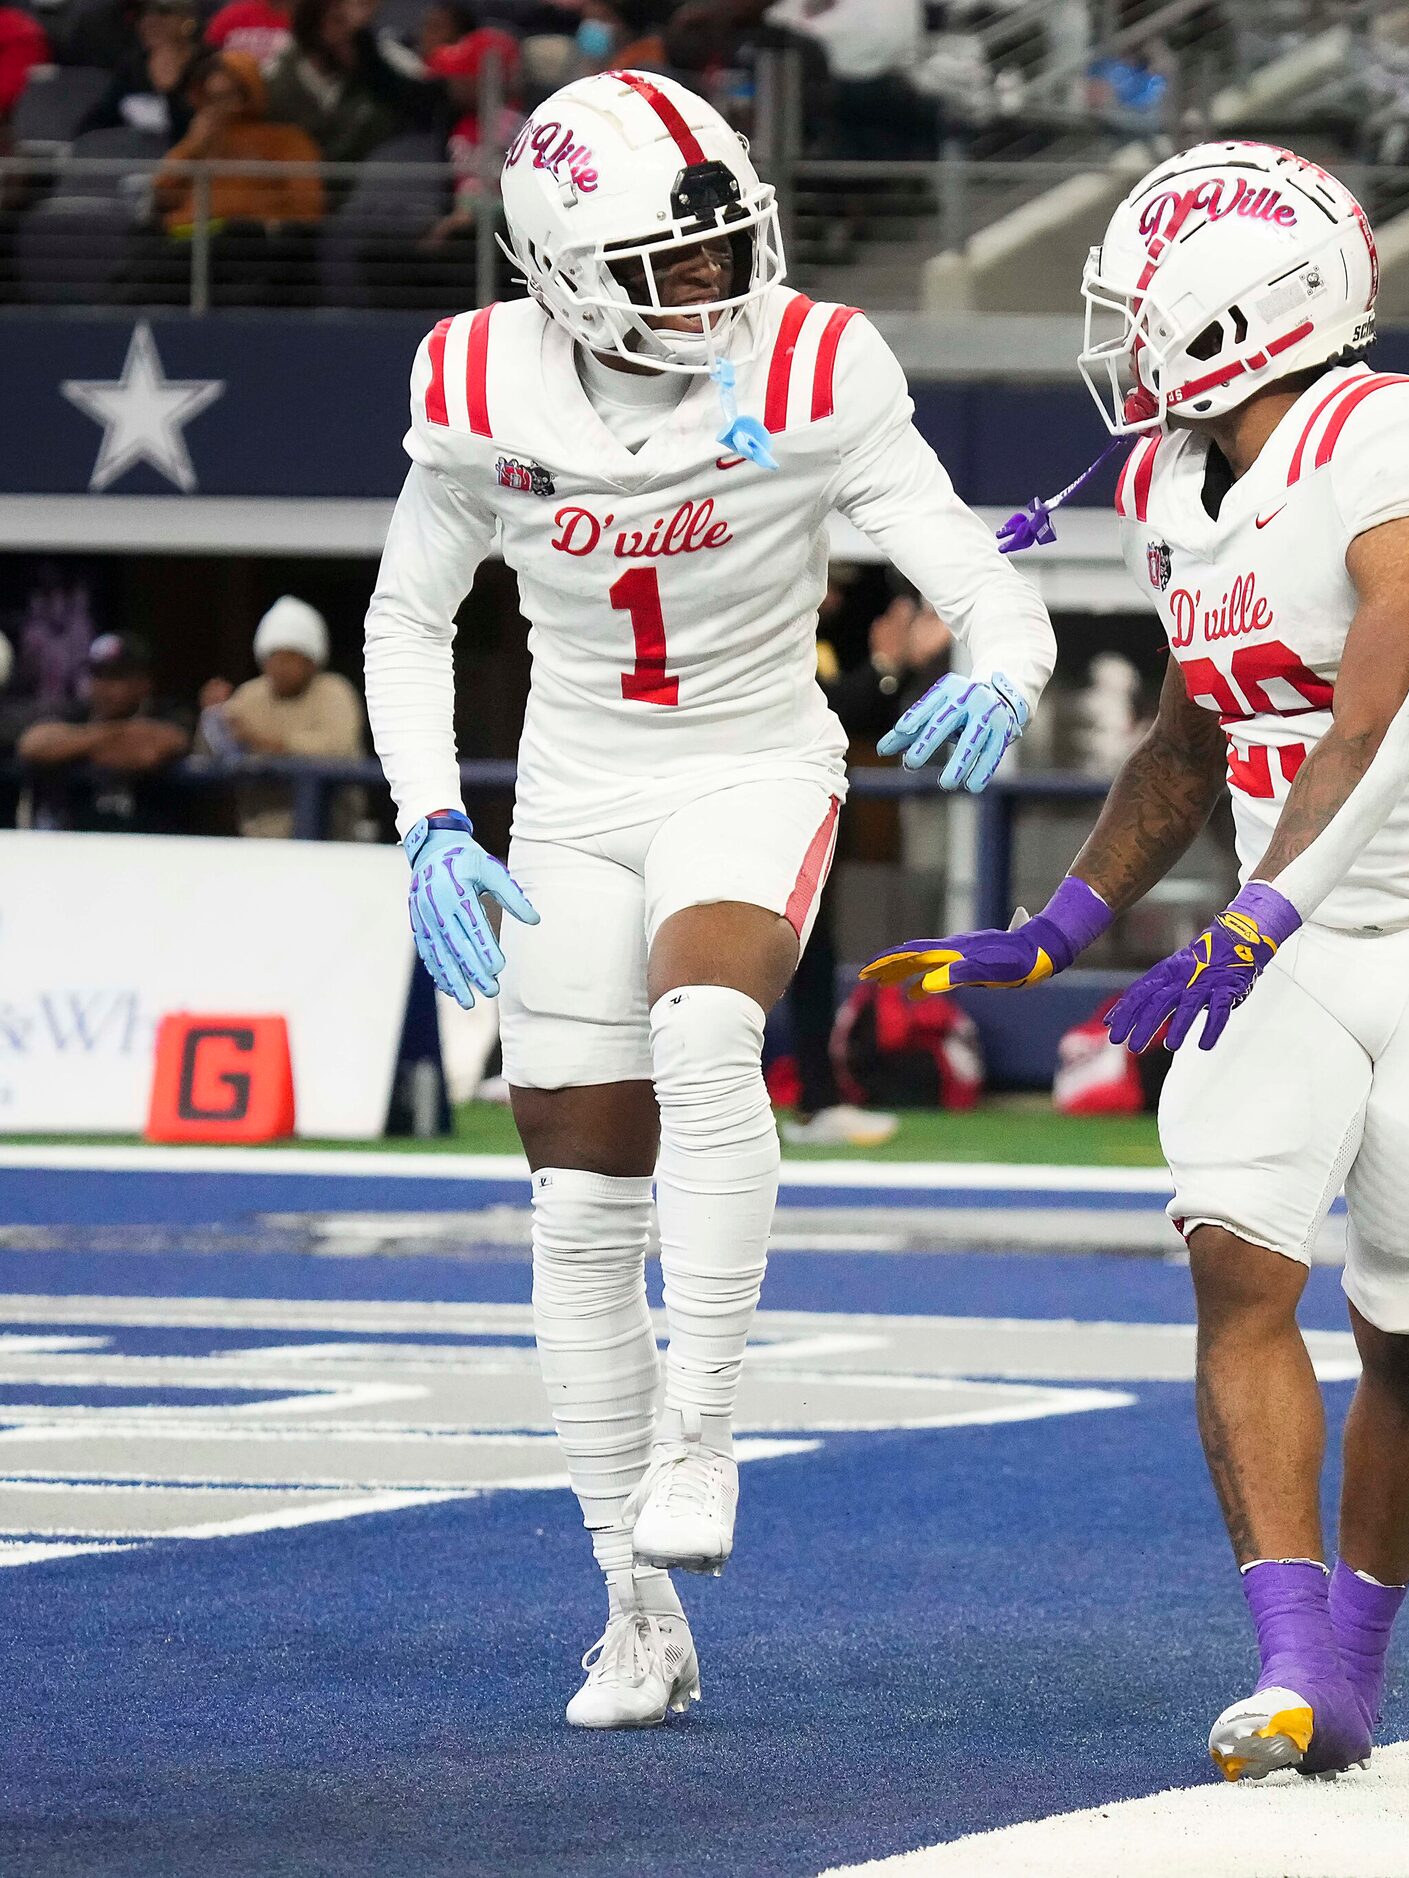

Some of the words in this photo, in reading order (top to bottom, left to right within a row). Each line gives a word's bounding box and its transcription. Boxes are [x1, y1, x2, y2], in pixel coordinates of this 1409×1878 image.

[551, 498, 734, 557] D'ville
[609, 566, 680, 706] 1
[1169, 571, 1274, 649] D'ville
[177, 1027, 255, 1121] G
